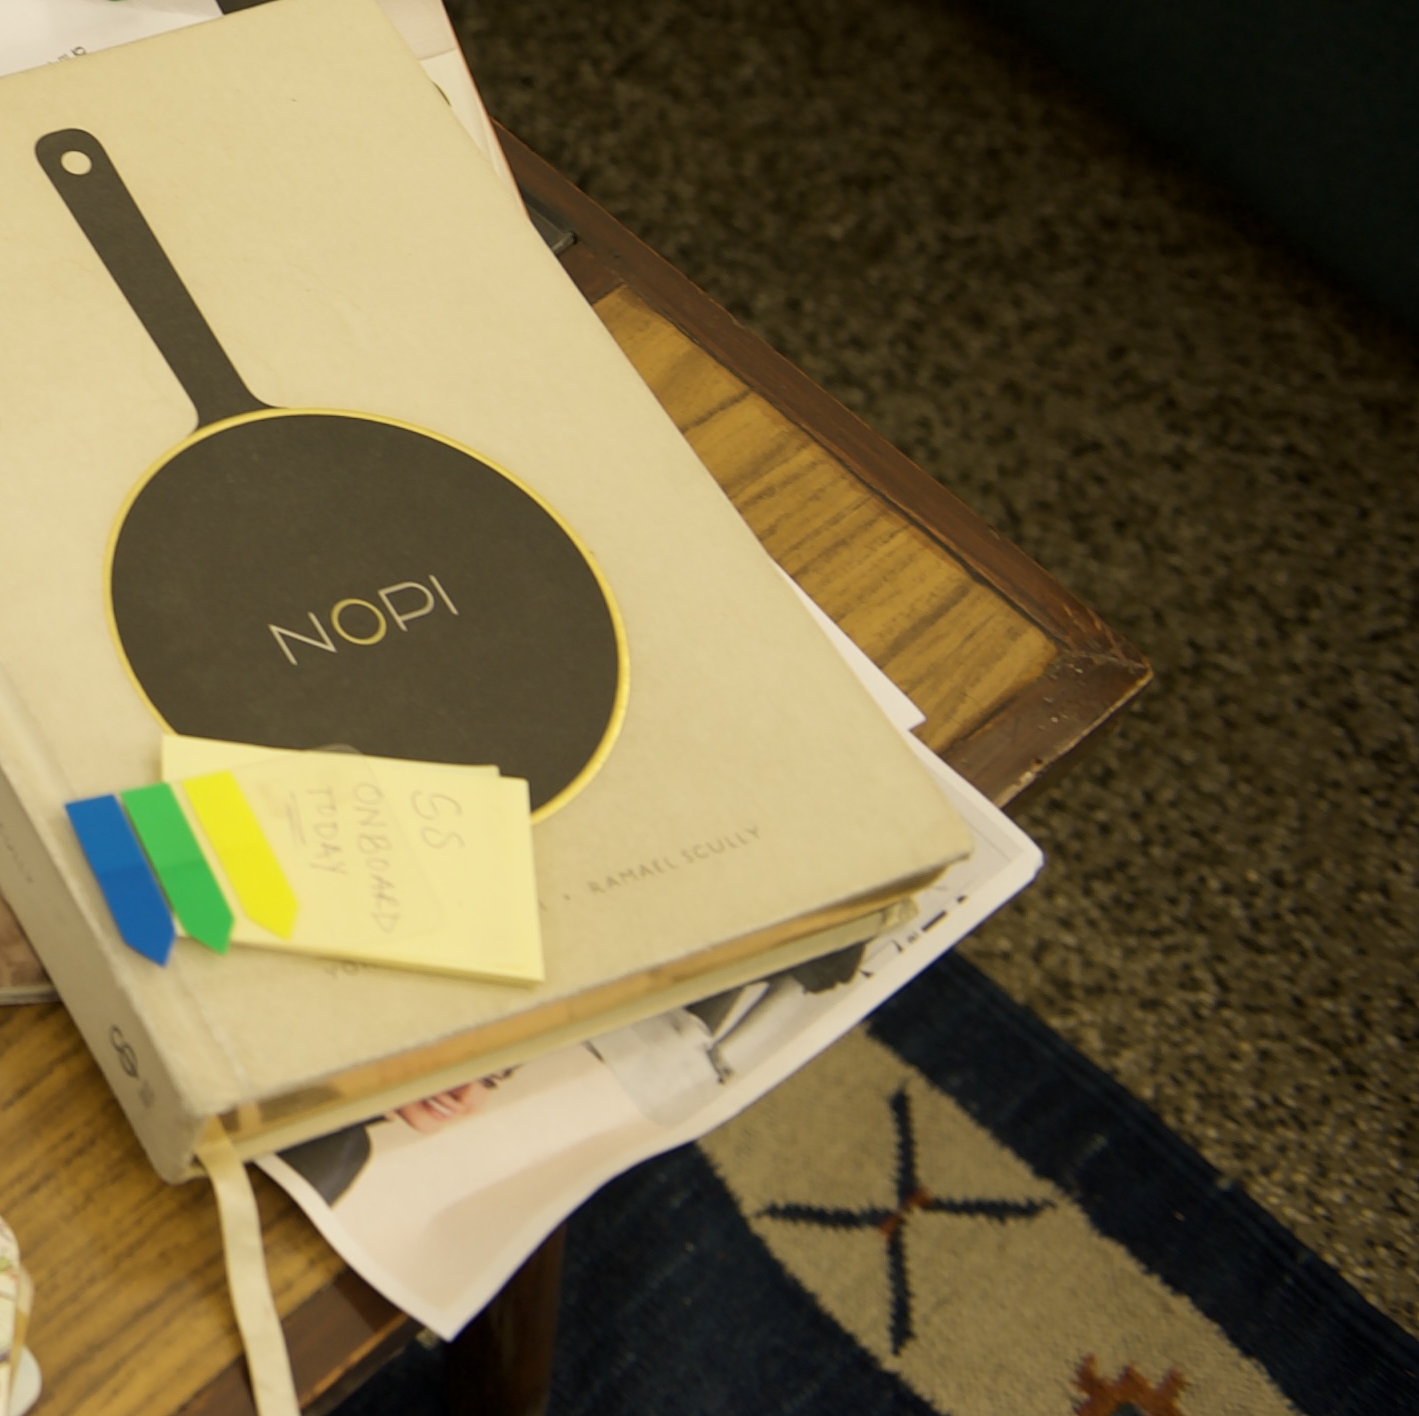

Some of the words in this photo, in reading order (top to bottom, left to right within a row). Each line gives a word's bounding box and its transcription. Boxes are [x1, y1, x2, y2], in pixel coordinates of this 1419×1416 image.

[268, 573, 460, 667] NOPI
[306, 782, 348, 877] TODAY
[354, 780, 404, 936] ONBOARD
[587, 856, 676, 896] RAMAEL
[680, 824, 762, 866] SCULLY
